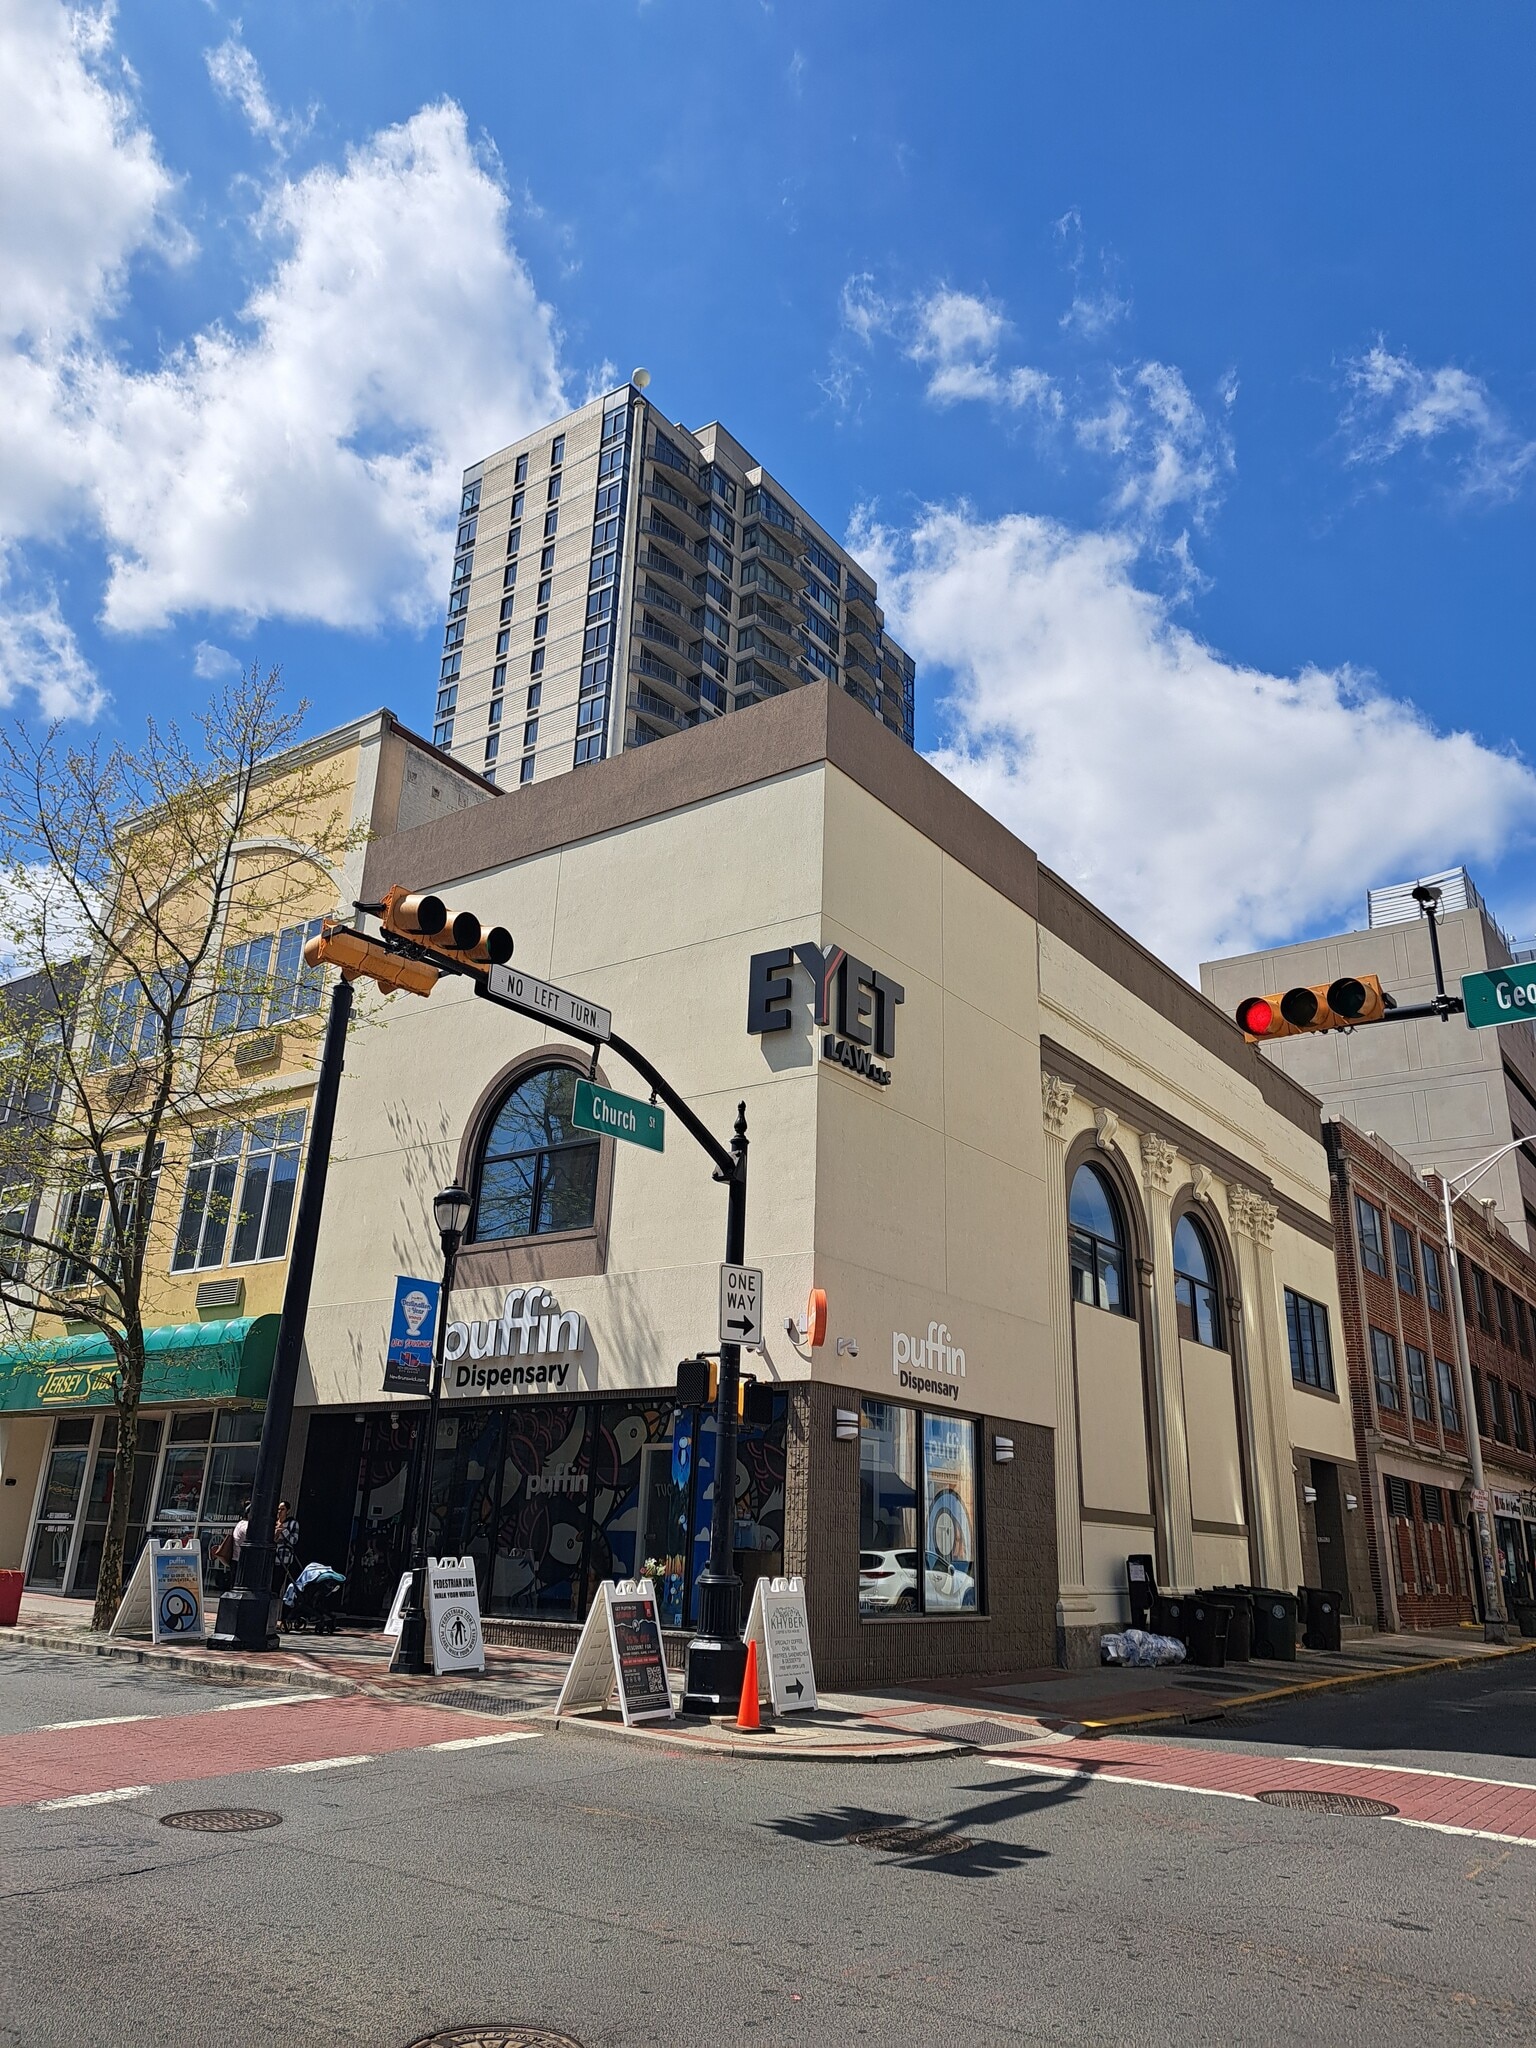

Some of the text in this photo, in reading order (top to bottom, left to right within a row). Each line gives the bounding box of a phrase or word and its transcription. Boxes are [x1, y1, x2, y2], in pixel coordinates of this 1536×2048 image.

[506, 974, 599, 1029] NO LEFT TURN
[747, 941, 905, 1058] EYET
[1496, 982, 1536, 1009] Geo
[824, 1034, 874, 1075] LAW
[591, 1096, 657, 1132] Church St
[728, 1273, 756, 1292] ONE
[727, 1292, 756, 1312] WAY
[443, 1286, 582, 1376] puffin
[892, 1321, 967, 1377] puffin
[456, 1364, 570, 1390] Dispensary
[900, 1370, 959, 1401] Dispensary
[526, 1462, 589, 1499] puffin
[433, 1577, 474, 1589] PEDESTRIAN ZONE
[771, 1617, 804, 1630] KHYBER
